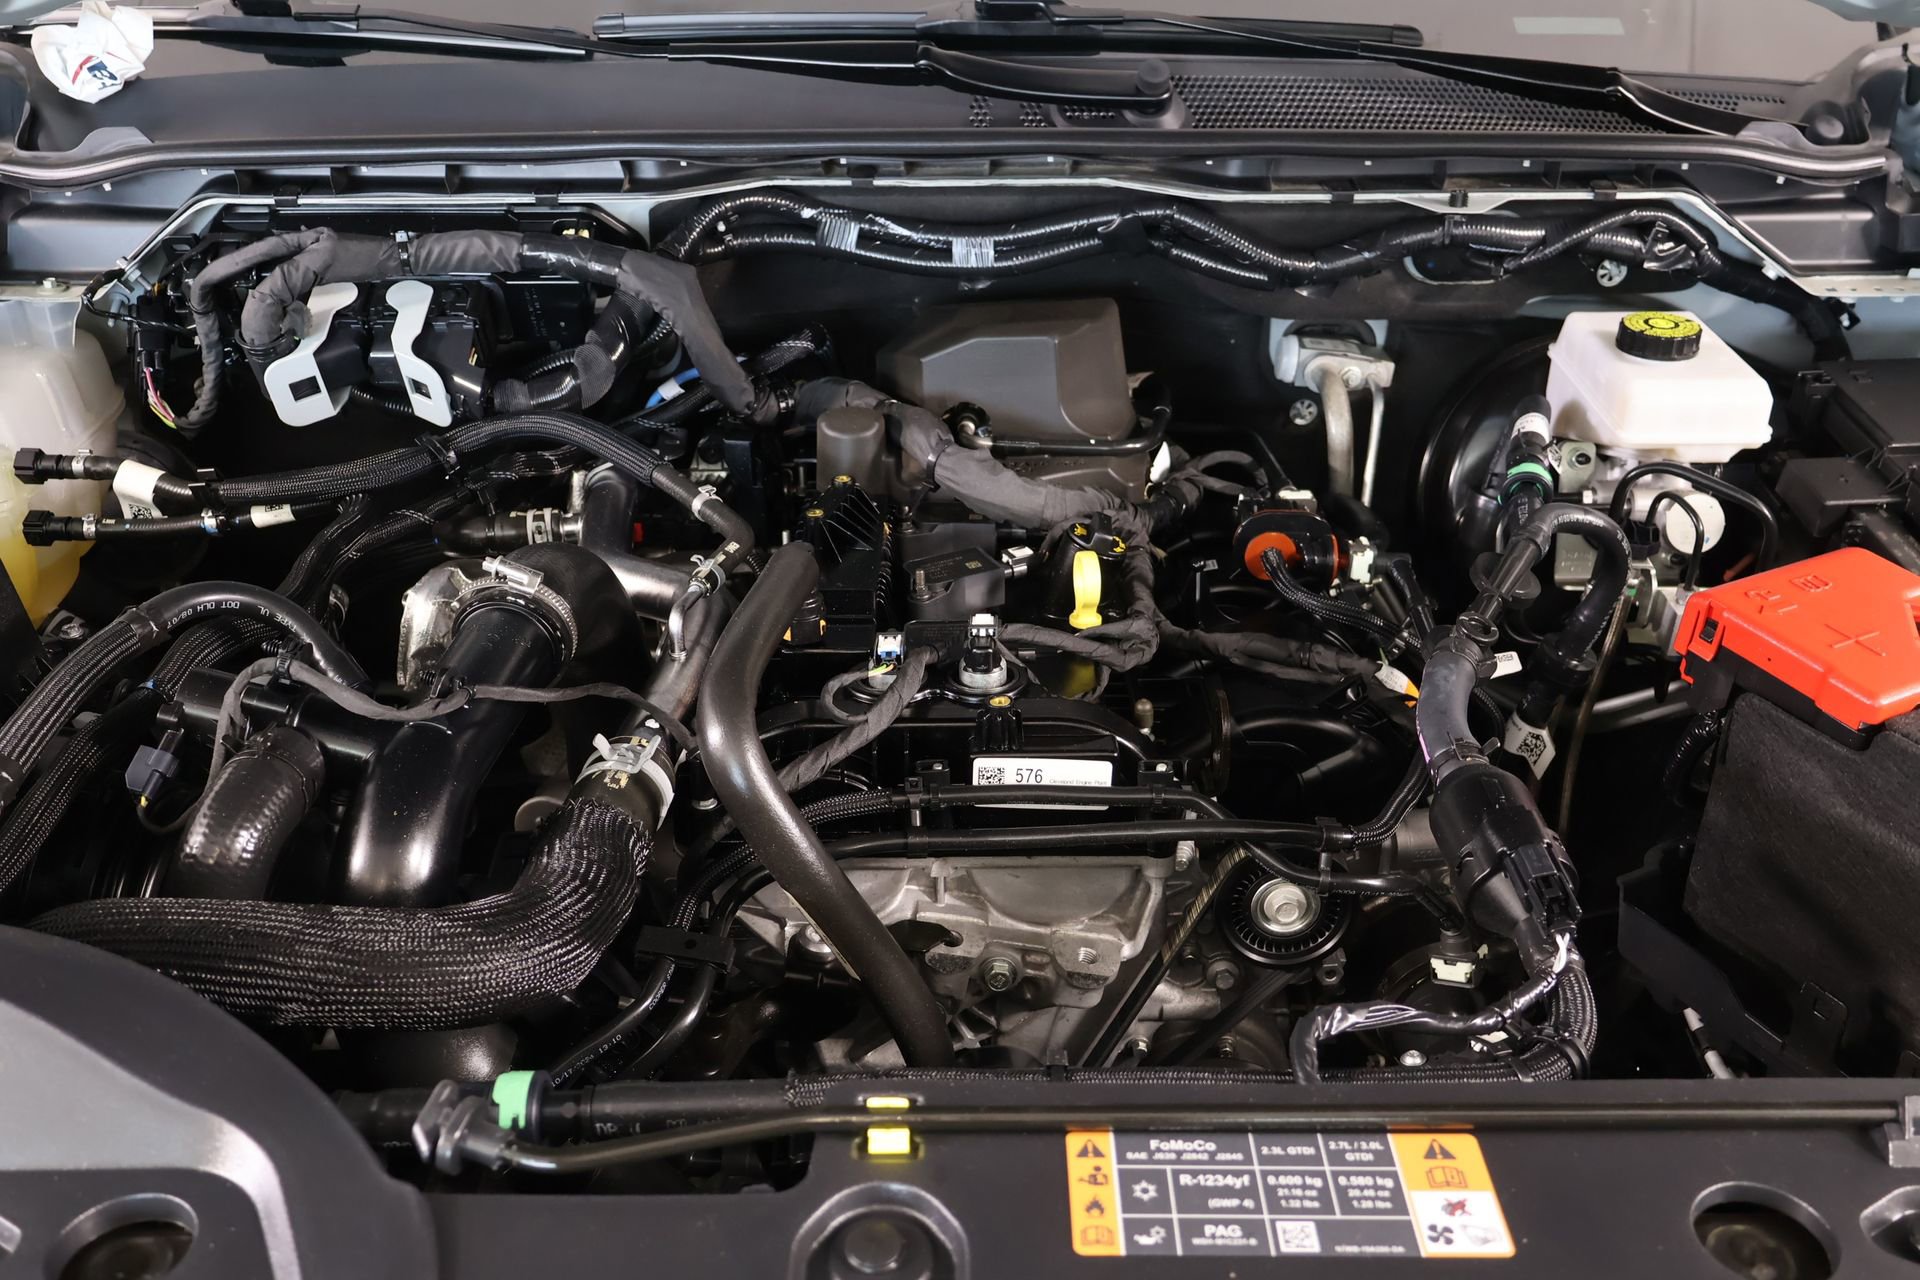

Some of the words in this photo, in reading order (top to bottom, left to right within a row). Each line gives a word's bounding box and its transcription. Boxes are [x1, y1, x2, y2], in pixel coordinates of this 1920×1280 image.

[196, 602, 216, 613] DLH
[220, 601, 241, 610] DOT
[1015, 768, 1043, 784] 576
[1149, 1139, 1218, 1152] FoMoCo
[1260, 1145, 1286, 1156] 2.3L
[1328, 1140, 1352, 1150] 2.7L
[1179, 1173, 1250, 1189] R-1234yf
[1304, 1174, 1324, 1188] kg
[1375, 1175, 1395, 1189] kg
[1203, 1223, 1244, 1238] PAG
